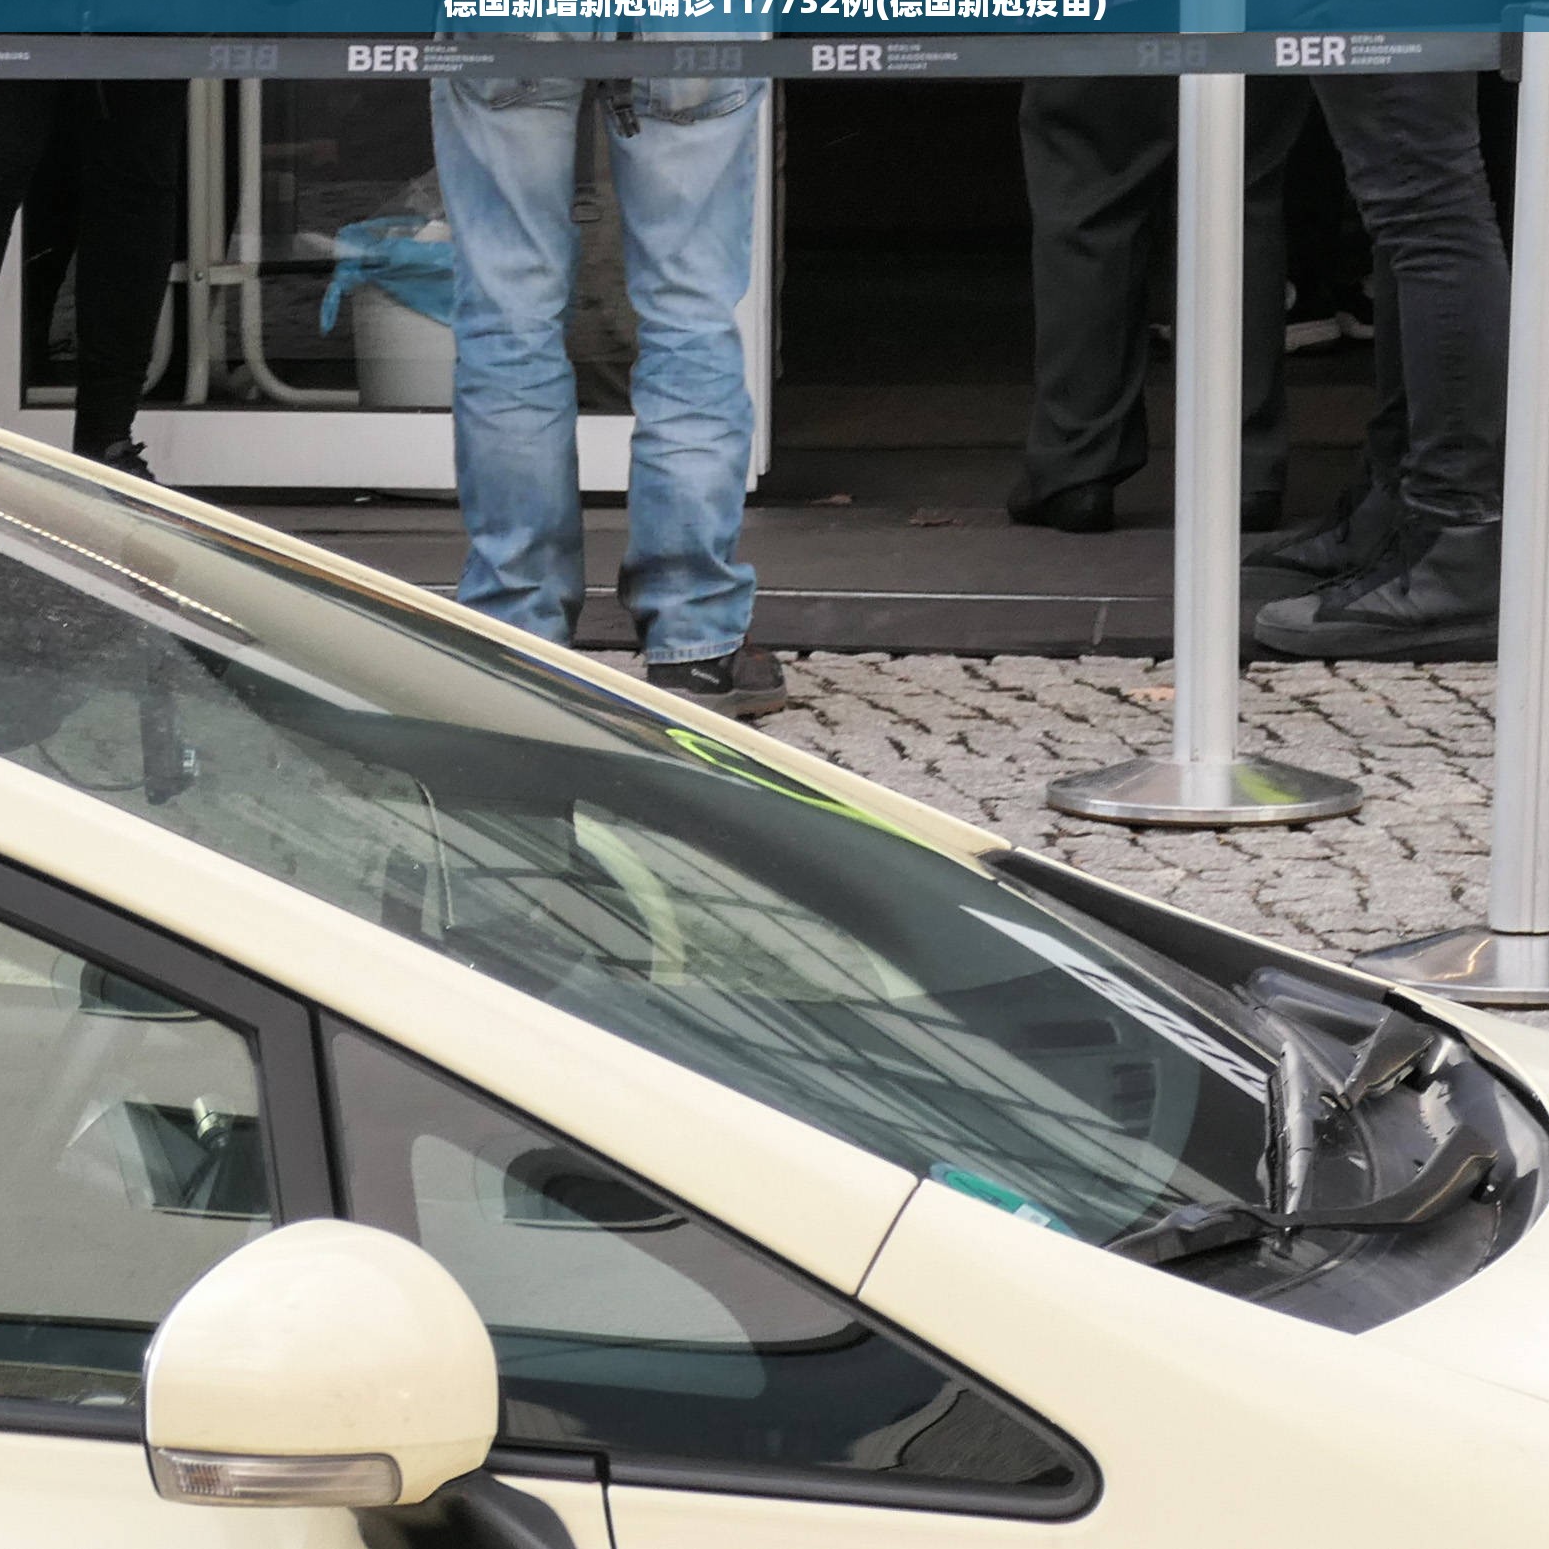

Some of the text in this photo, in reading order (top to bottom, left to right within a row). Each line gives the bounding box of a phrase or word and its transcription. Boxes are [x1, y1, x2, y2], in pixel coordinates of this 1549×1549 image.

[348, 45, 418, 72] BER
[812, 45, 882, 71] BER
[1276, 36, 1346, 67] BER
